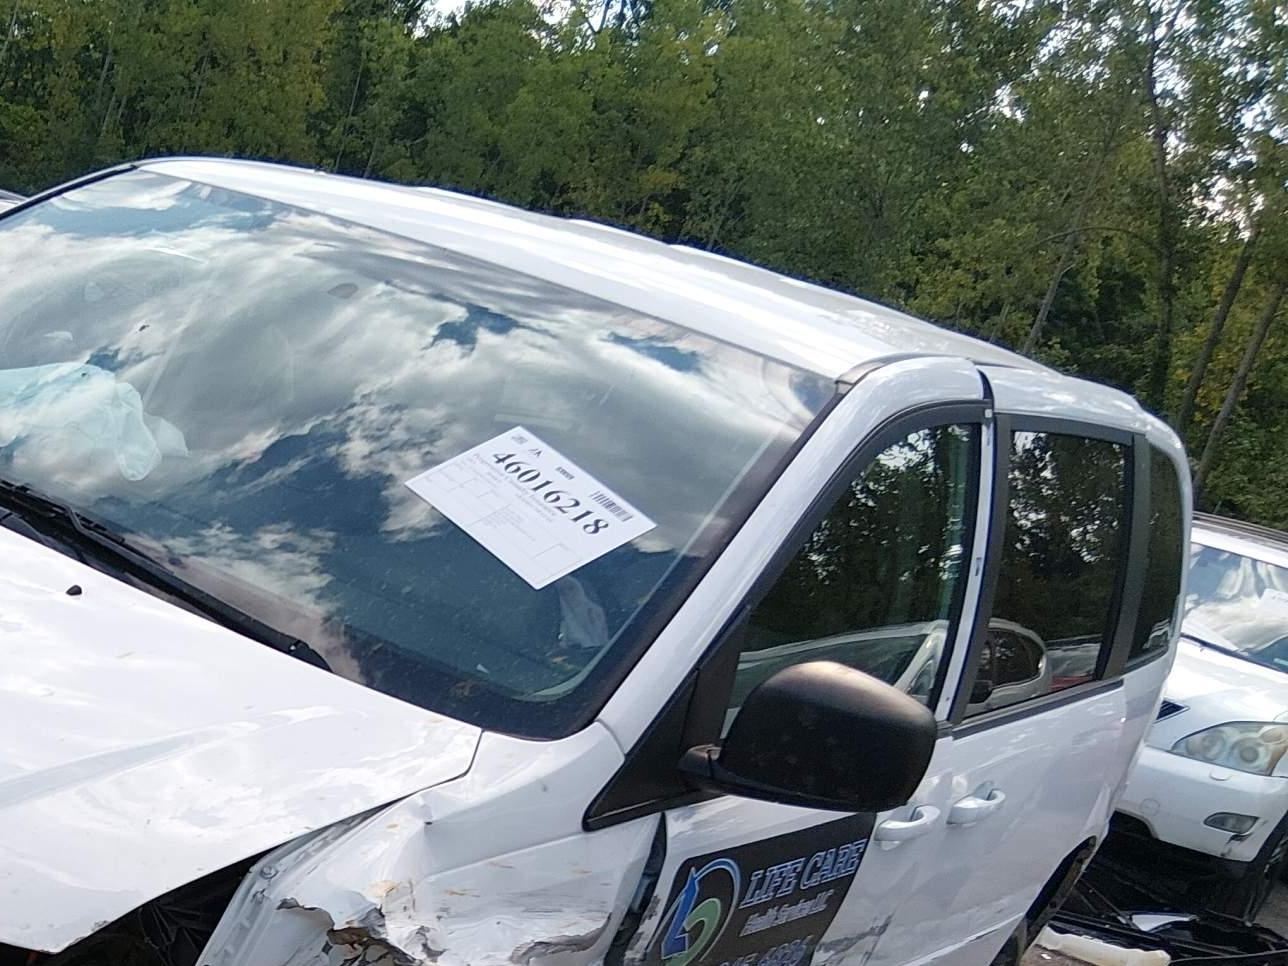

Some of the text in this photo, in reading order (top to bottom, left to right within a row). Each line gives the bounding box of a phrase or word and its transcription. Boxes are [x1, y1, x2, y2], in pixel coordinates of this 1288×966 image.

[492, 451, 609, 535] 46016218
[738, 838, 868, 909] LIFE CARE
